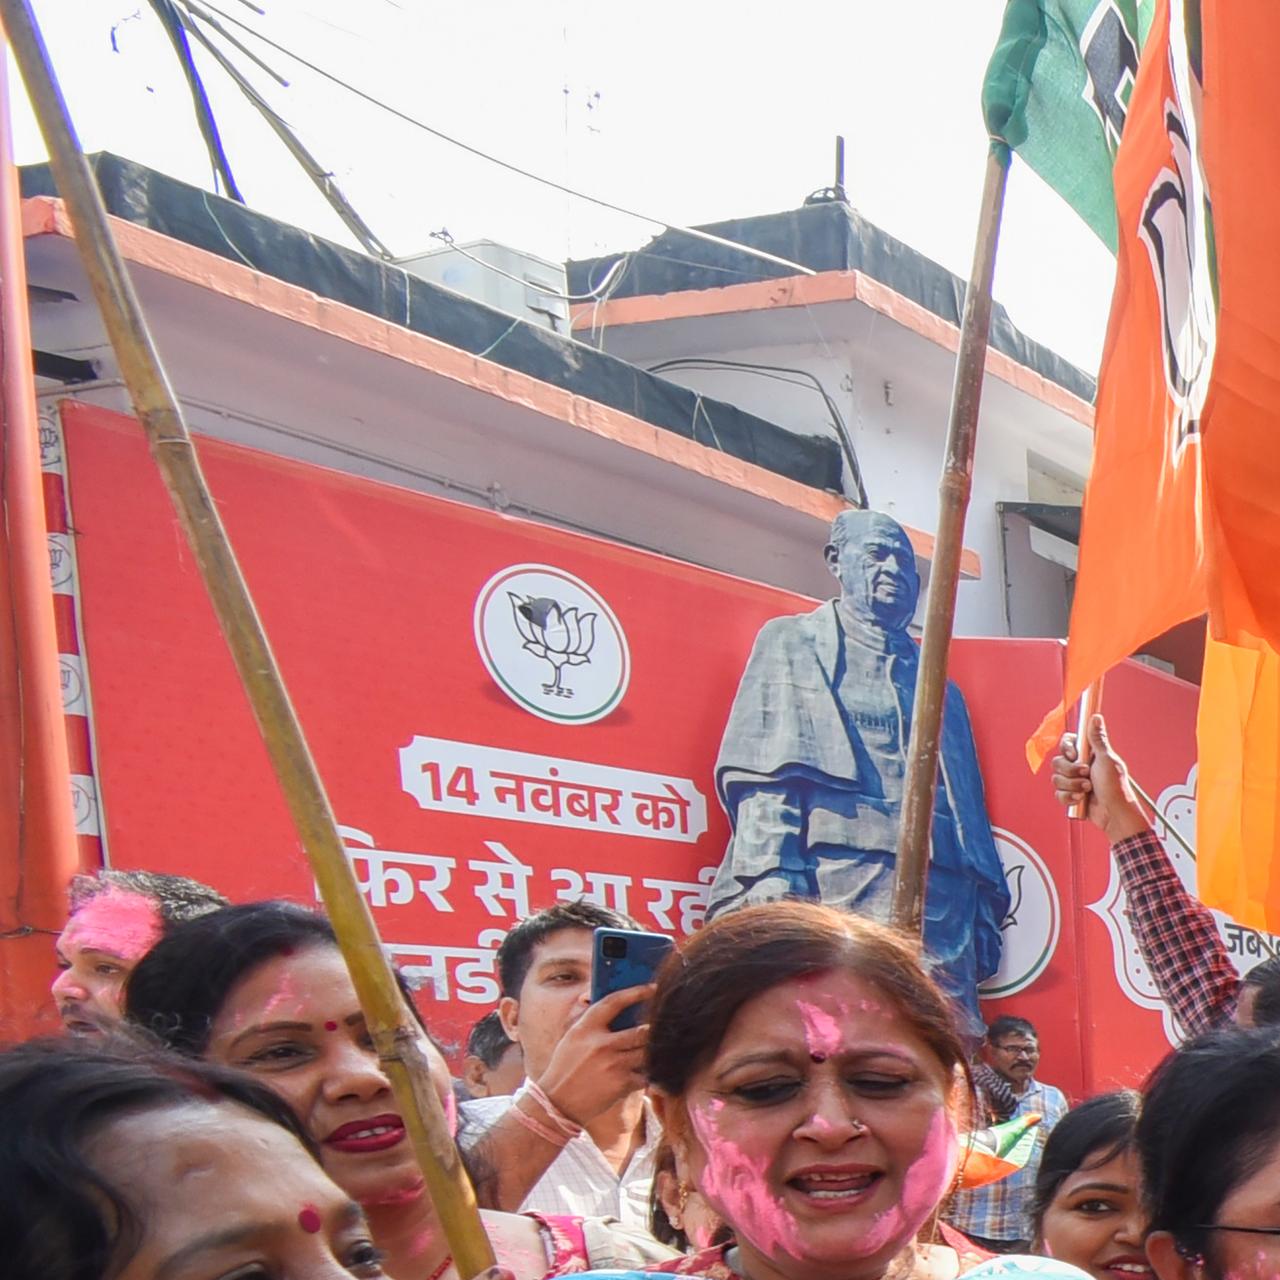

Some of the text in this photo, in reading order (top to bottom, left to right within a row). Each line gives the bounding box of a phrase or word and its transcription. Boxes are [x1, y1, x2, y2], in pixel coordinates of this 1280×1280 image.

[421, 761, 691, 835] 14 नवंबर को
[468, 840, 534, 922] से
